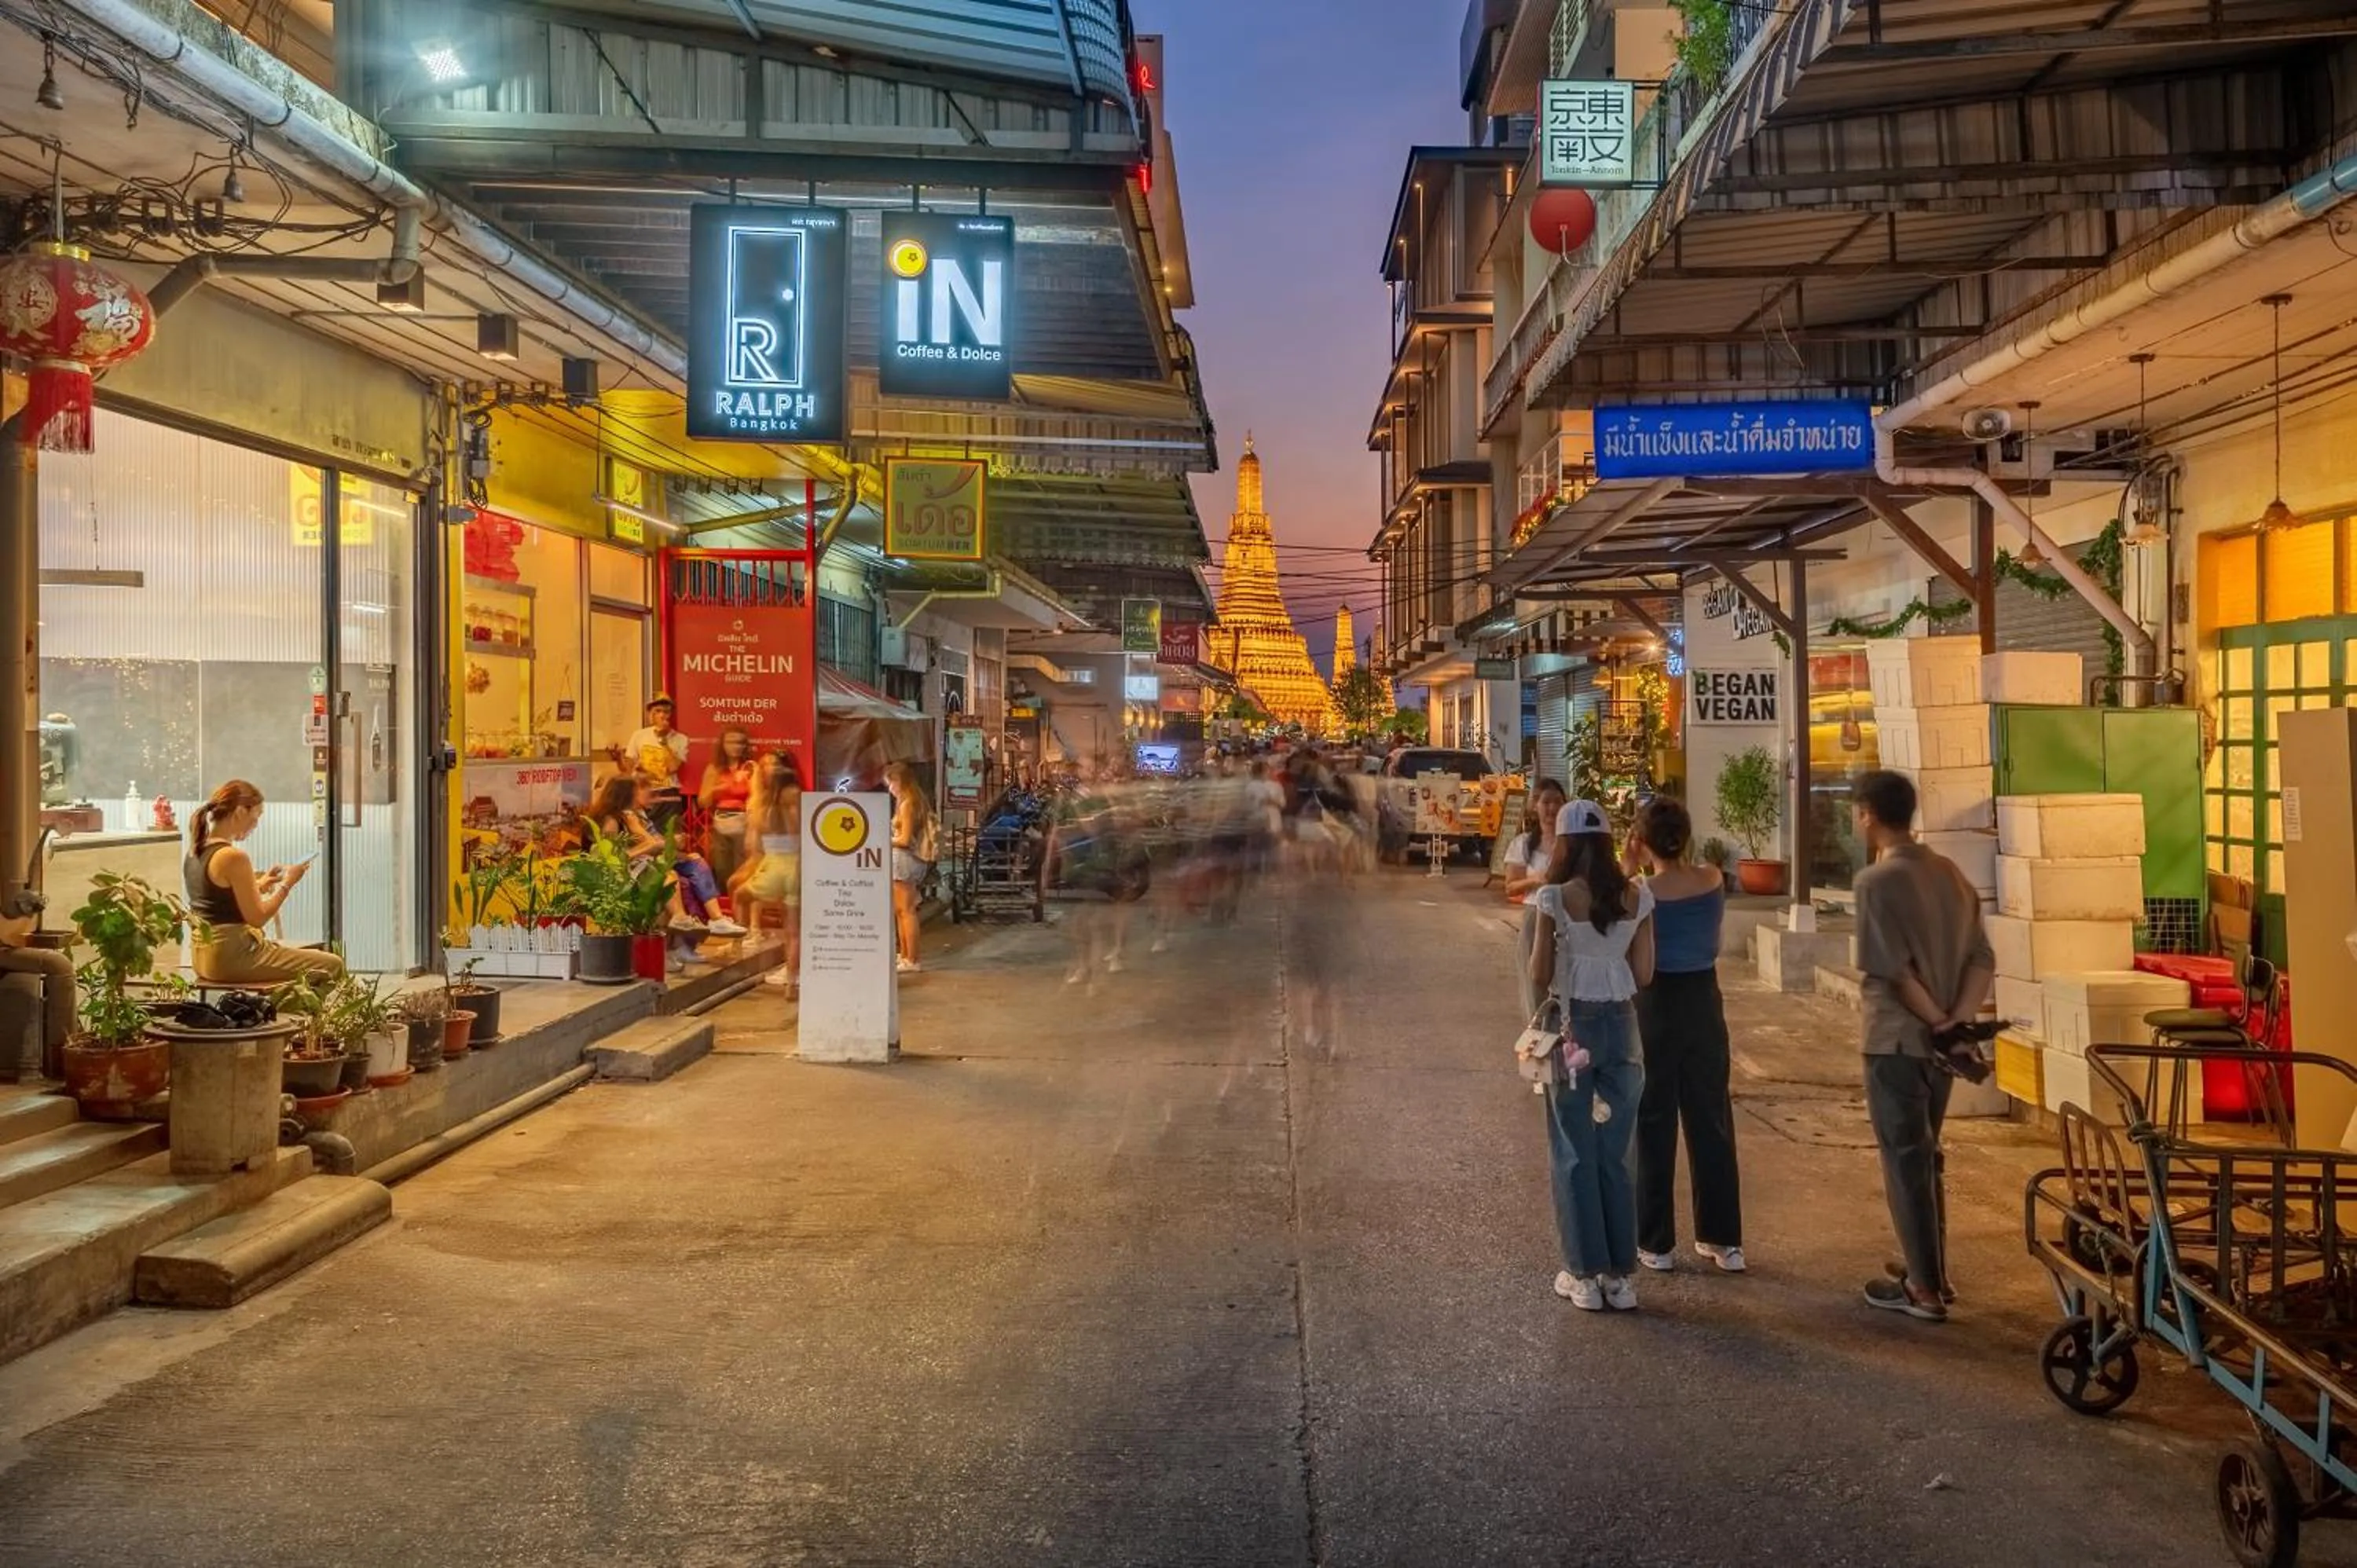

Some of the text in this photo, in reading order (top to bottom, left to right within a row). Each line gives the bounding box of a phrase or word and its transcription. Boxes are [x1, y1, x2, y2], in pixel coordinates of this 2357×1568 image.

[897, 344, 1001, 361] Coffee & Dolce
[716, 392, 815, 417] RALPH
[729, 417, 797, 430] Bangkok
[683, 654, 793, 673] MICHELIN
[1694, 672, 1776, 696] BEGAN
[700, 696, 777, 709] SOMTUM DER
[1695, 698, 1776, 720] VEGAN
